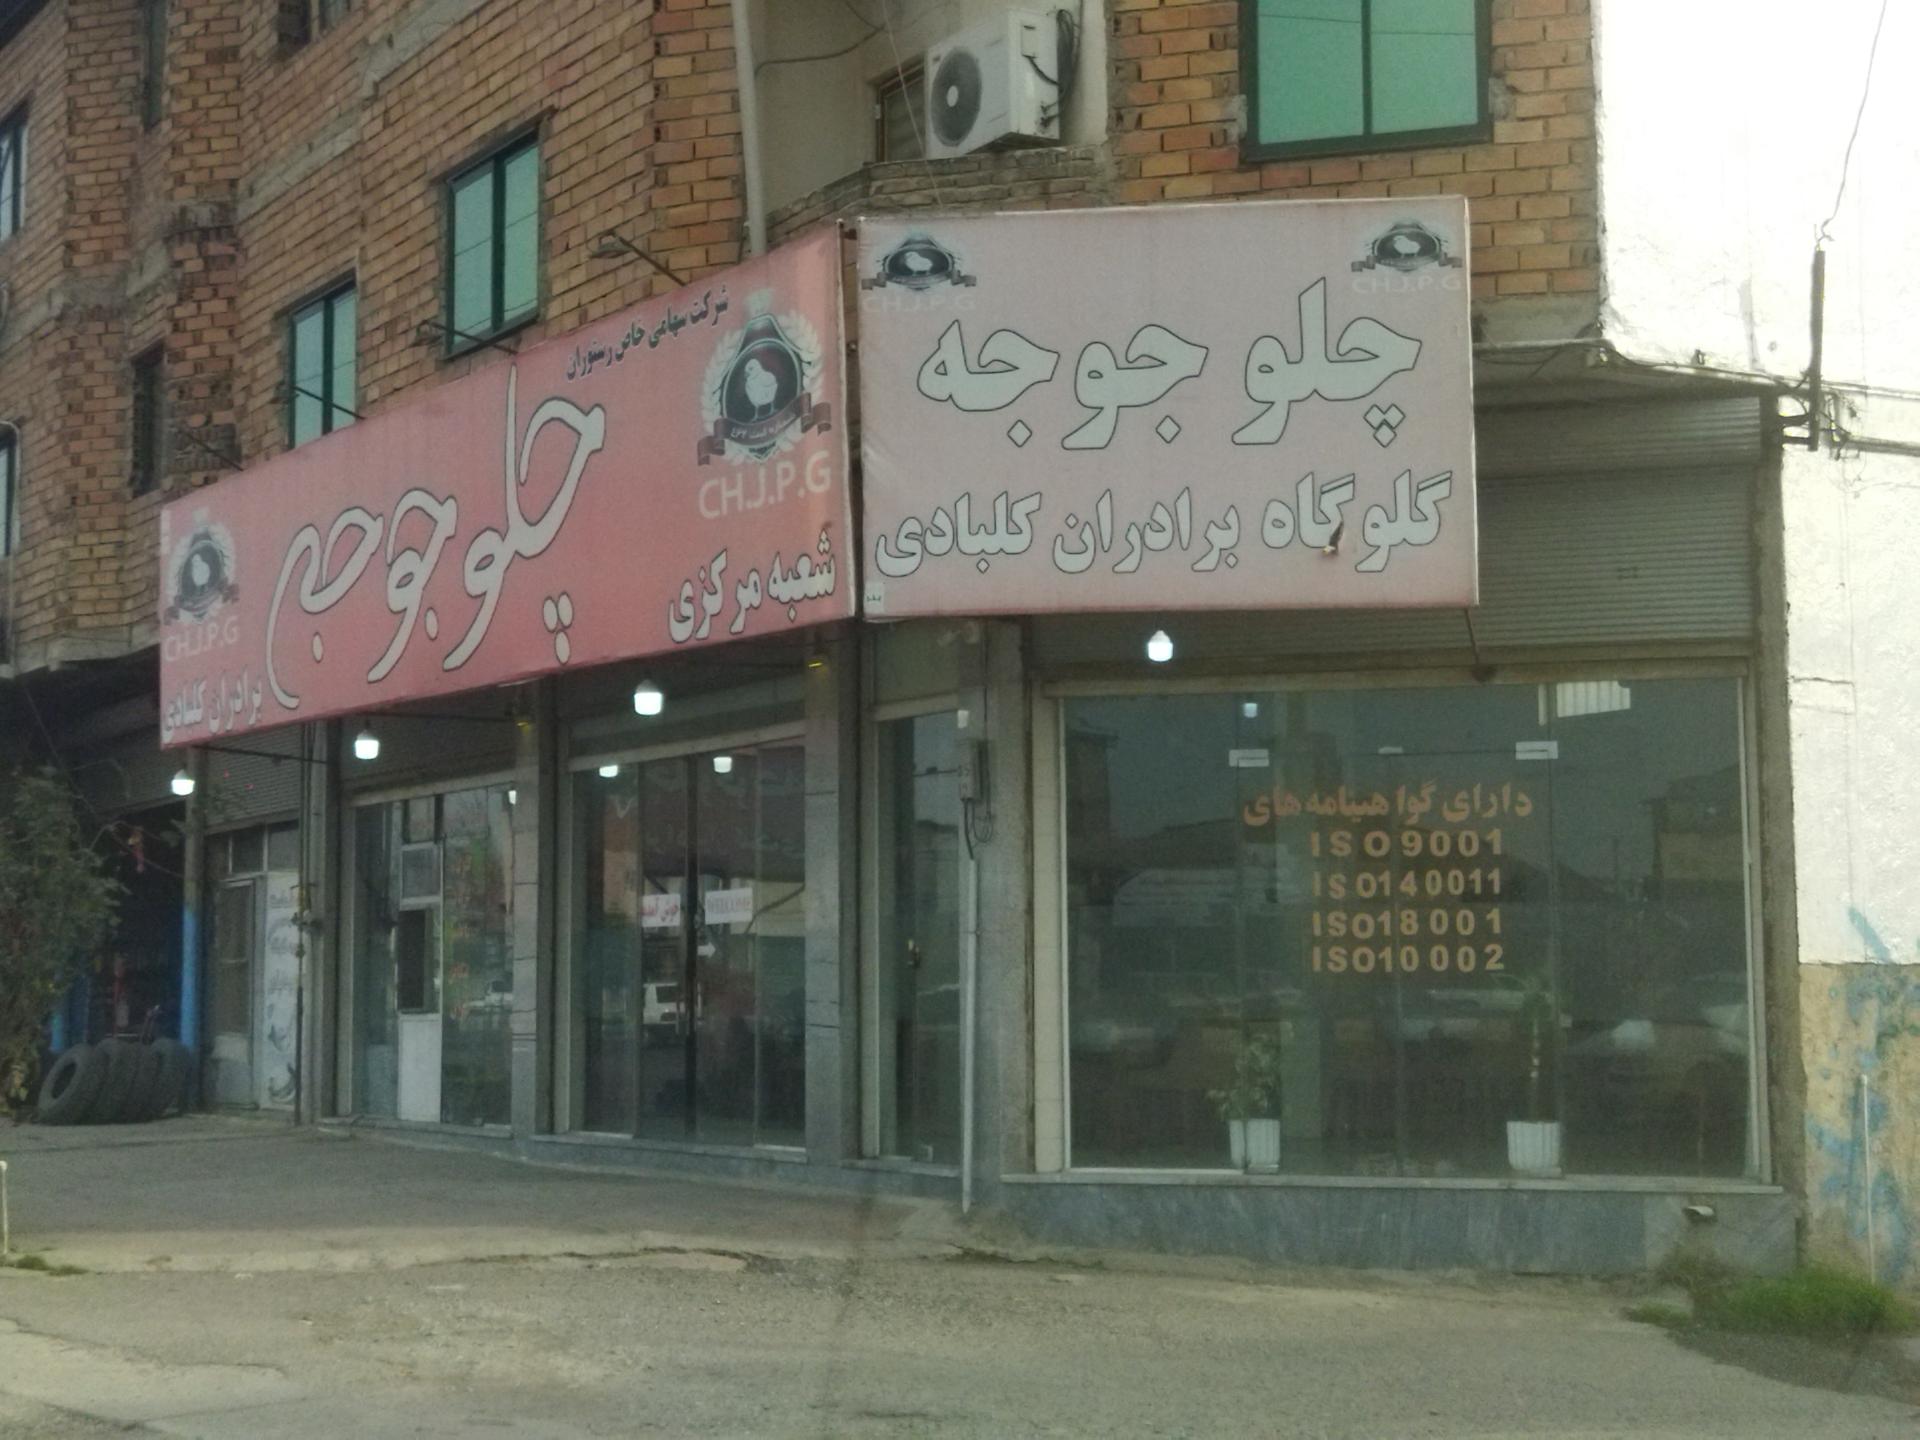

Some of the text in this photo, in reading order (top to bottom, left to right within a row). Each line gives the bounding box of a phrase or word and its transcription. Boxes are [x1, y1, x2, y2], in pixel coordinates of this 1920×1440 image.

[566, 284, 729, 381] شرکت سهامی خاص رستوران
[917, 276, 1423, 450] چلو جوجه
[443, 361, 607, 665] چلو
[1053, 486, 1241, 574] برادران
[668, 527, 836, 644] شعبه مرکزی
[1442, 781, 1534, 823] دارای
